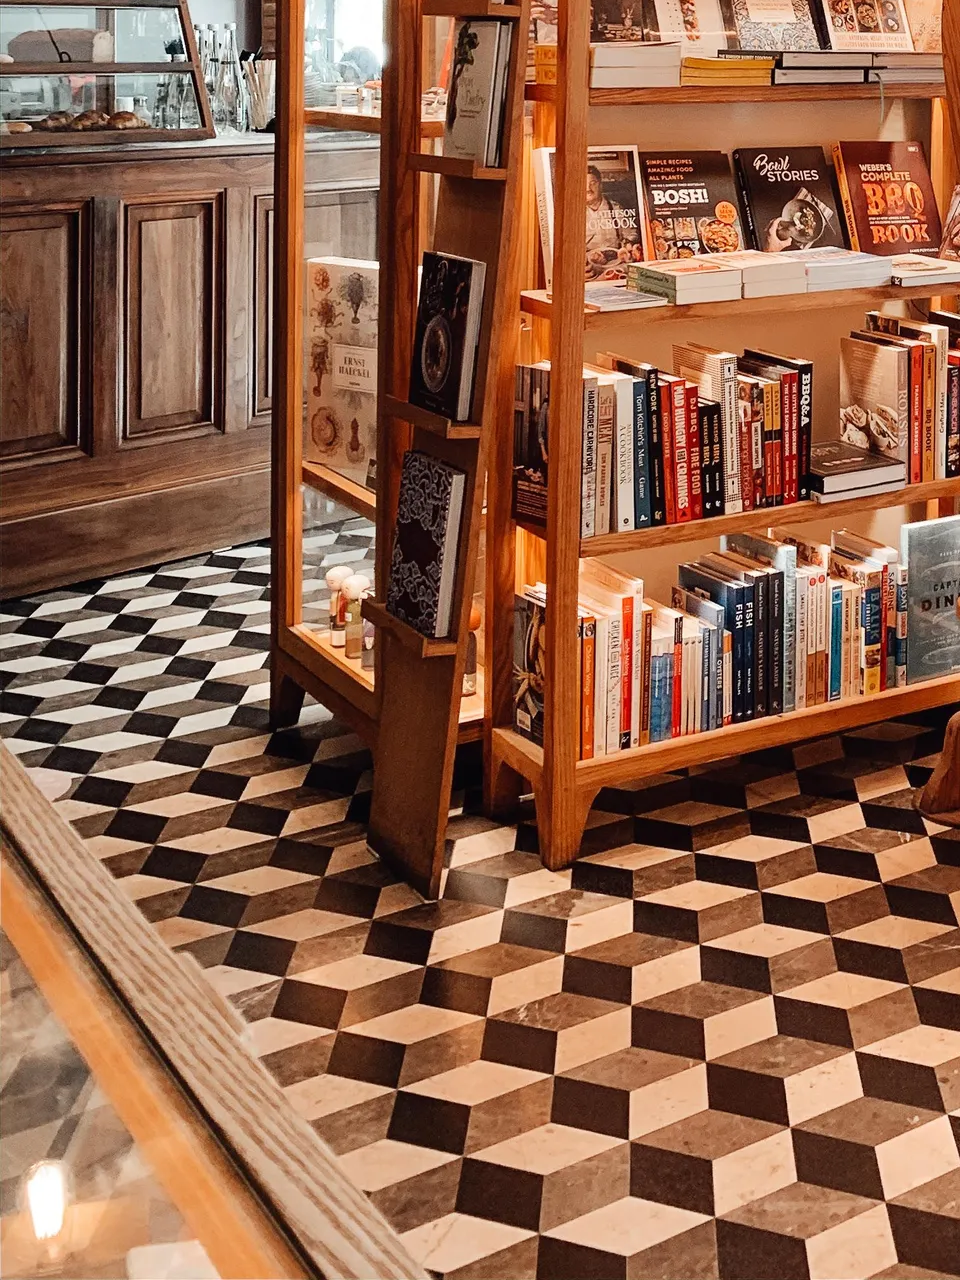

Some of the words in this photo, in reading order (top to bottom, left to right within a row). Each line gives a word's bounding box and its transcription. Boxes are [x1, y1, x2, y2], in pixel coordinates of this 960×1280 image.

[753, 153, 790, 176] Bowl
[767, 169, 819, 182] STORIES
[858, 163, 892, 171] WEBER'S
[860, 171, 911, 181] COMPLETE
[651, 188, 709, 205] BOSH!
[862, 180, 927, 220] BBQ
[870, 223, 931, 245] BOOK
[338, 365, 372, 379] HAECKEL
[343, 355, 366, 368] ERNST
[636, 394, 644, 414] Tom
[674, 385, 685, 407] MAD
[689, 397, 697, 410] DJ
[800, 373, 811, 427] BBQ&A
[586, 390, 596, 430] HARDCORE
[897, 389, 908, 447] ROASTS
[598, 419, 612, 445] MEAT
[636, 415, 645, 446] Kitchin's
[675, 408, 686, 448] HUNGRY
[689, 413, 697, 433] BBQ
[584, 430, 594, 472] CARNIVORE
[637, 448, 645, 467] Meat
[691, 447, 700, 468] FIRE
[638, 477, 646, 498] Game
[676, 463, 689, 510] CRAVINGS
[692, 469, 701, 495] FOOD
[887, 571, 895, 612] SARDINE
[900, 587, 908, 609] BOAT
[735, 604, 743, 629] FISH
[745, 602, 753, 627] FISH
[870, 592, 879, 640] BALIK
[611, 620, 621, 650] CHICKEN
[584, 645, 592, 673] Chicken
[610, 664, 620, 680] RICE
[584, 674, 592, 696] Wings
